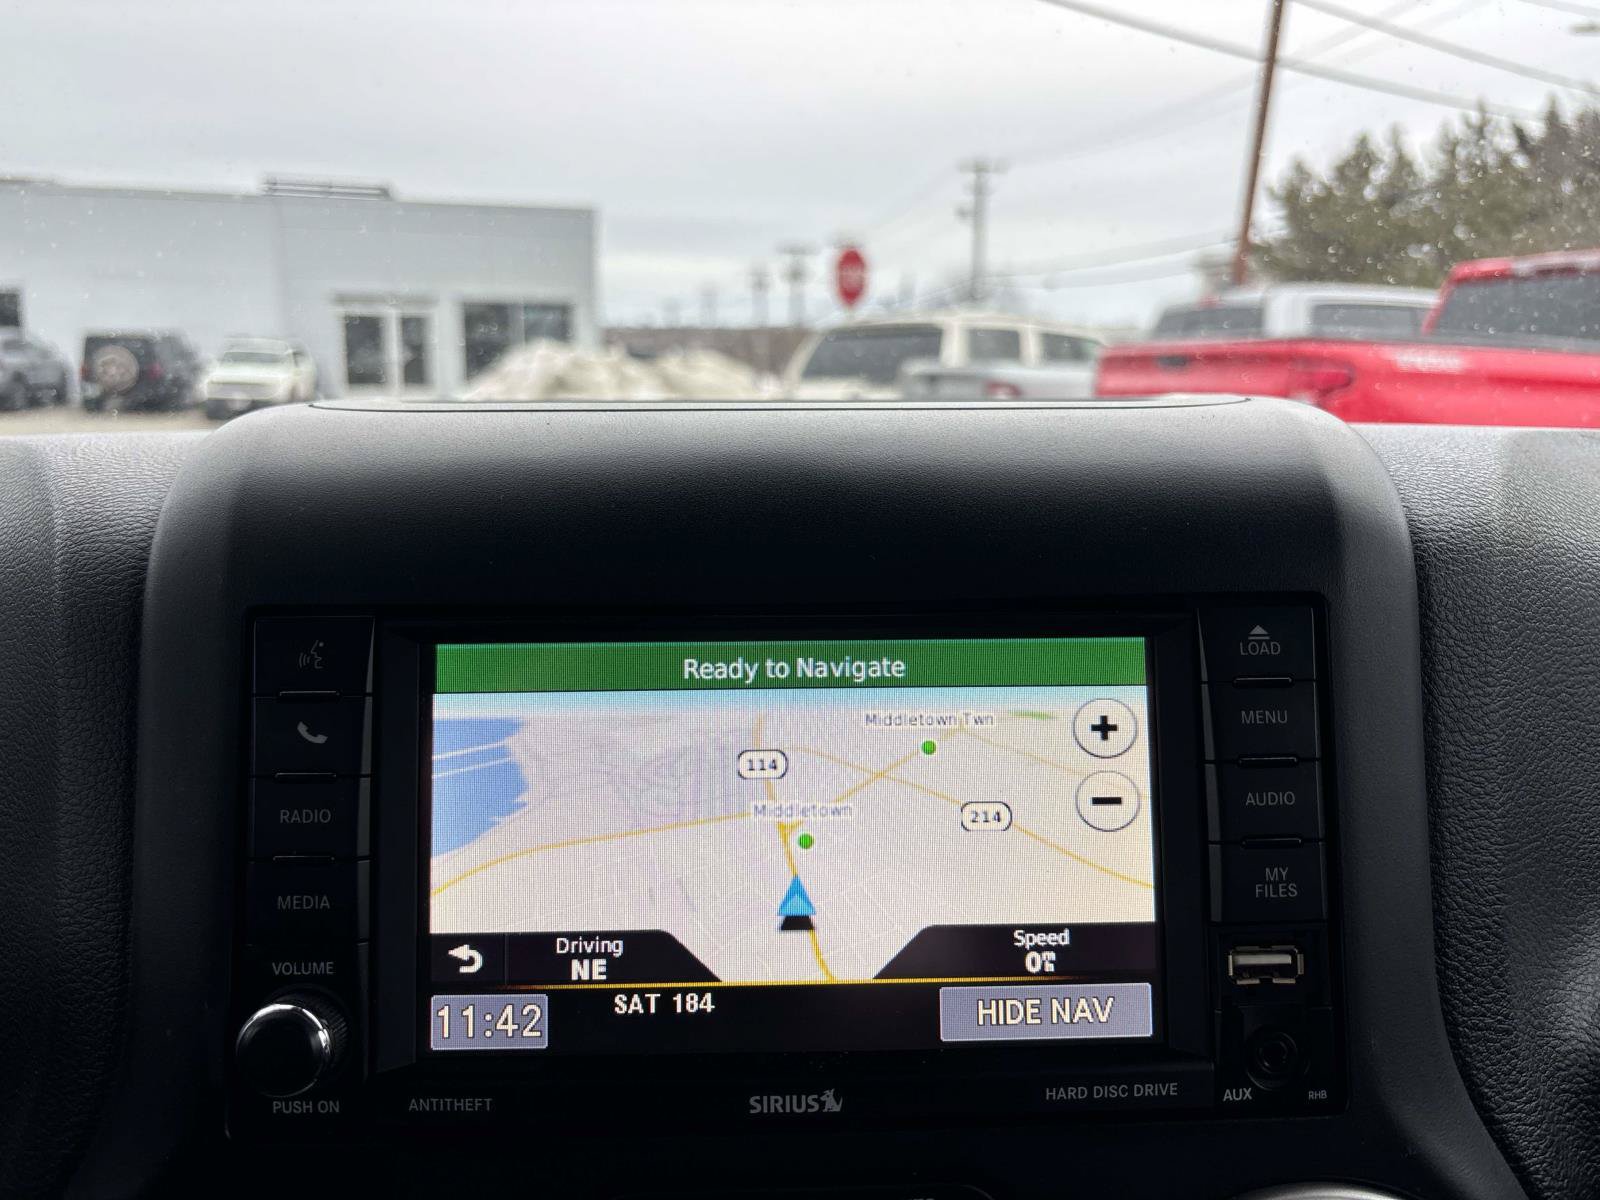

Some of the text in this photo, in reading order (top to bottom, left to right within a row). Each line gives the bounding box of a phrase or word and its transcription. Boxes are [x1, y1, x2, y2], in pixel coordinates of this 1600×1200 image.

[1240, 642, 1281, 655] LOAD
[683, 656, 906, 683] Ready to Navigate
[865, 712, 993, 726] Middletown Twn
[1241, 710, 1288, 724] MENU
[747, 758, 779, 771] 114
[1245, 791, 1296, 806] AUDIO
[279, 809, 332, 824] RADIO
[753, 803, 853, 817] Middletown
[970, 810, 1001, 823] 214
[1265, 867, 1289, 882] MY
[1255, 883, 1298, 898] FILES
[277, 895, 331, 910] MEDIA
[1013, 928, 1070, 950] Speed
[556, 937, 624, 957] Driving
[272, 961, 335, 976] VOLUME
[571, 959, 607, 981] NE
[613, 992, 715, 1014] SAT 184
[976, 997, 1115, 1026] HIDE NAV
[436, 1003, 543, 1039] 11:42
[1045, 1083, 1179, 1101] HARD DISC DRIVE
[1223, 1088, 1252, 1102] AUX
[1308, 1090, 1328, 1100] RHB
[272, 1100, 341, 1115] PUSH ON
[408, 1098, 493, 1113] ANTITHEFT
[749, 1095, 820, 1114] SIRIUS
